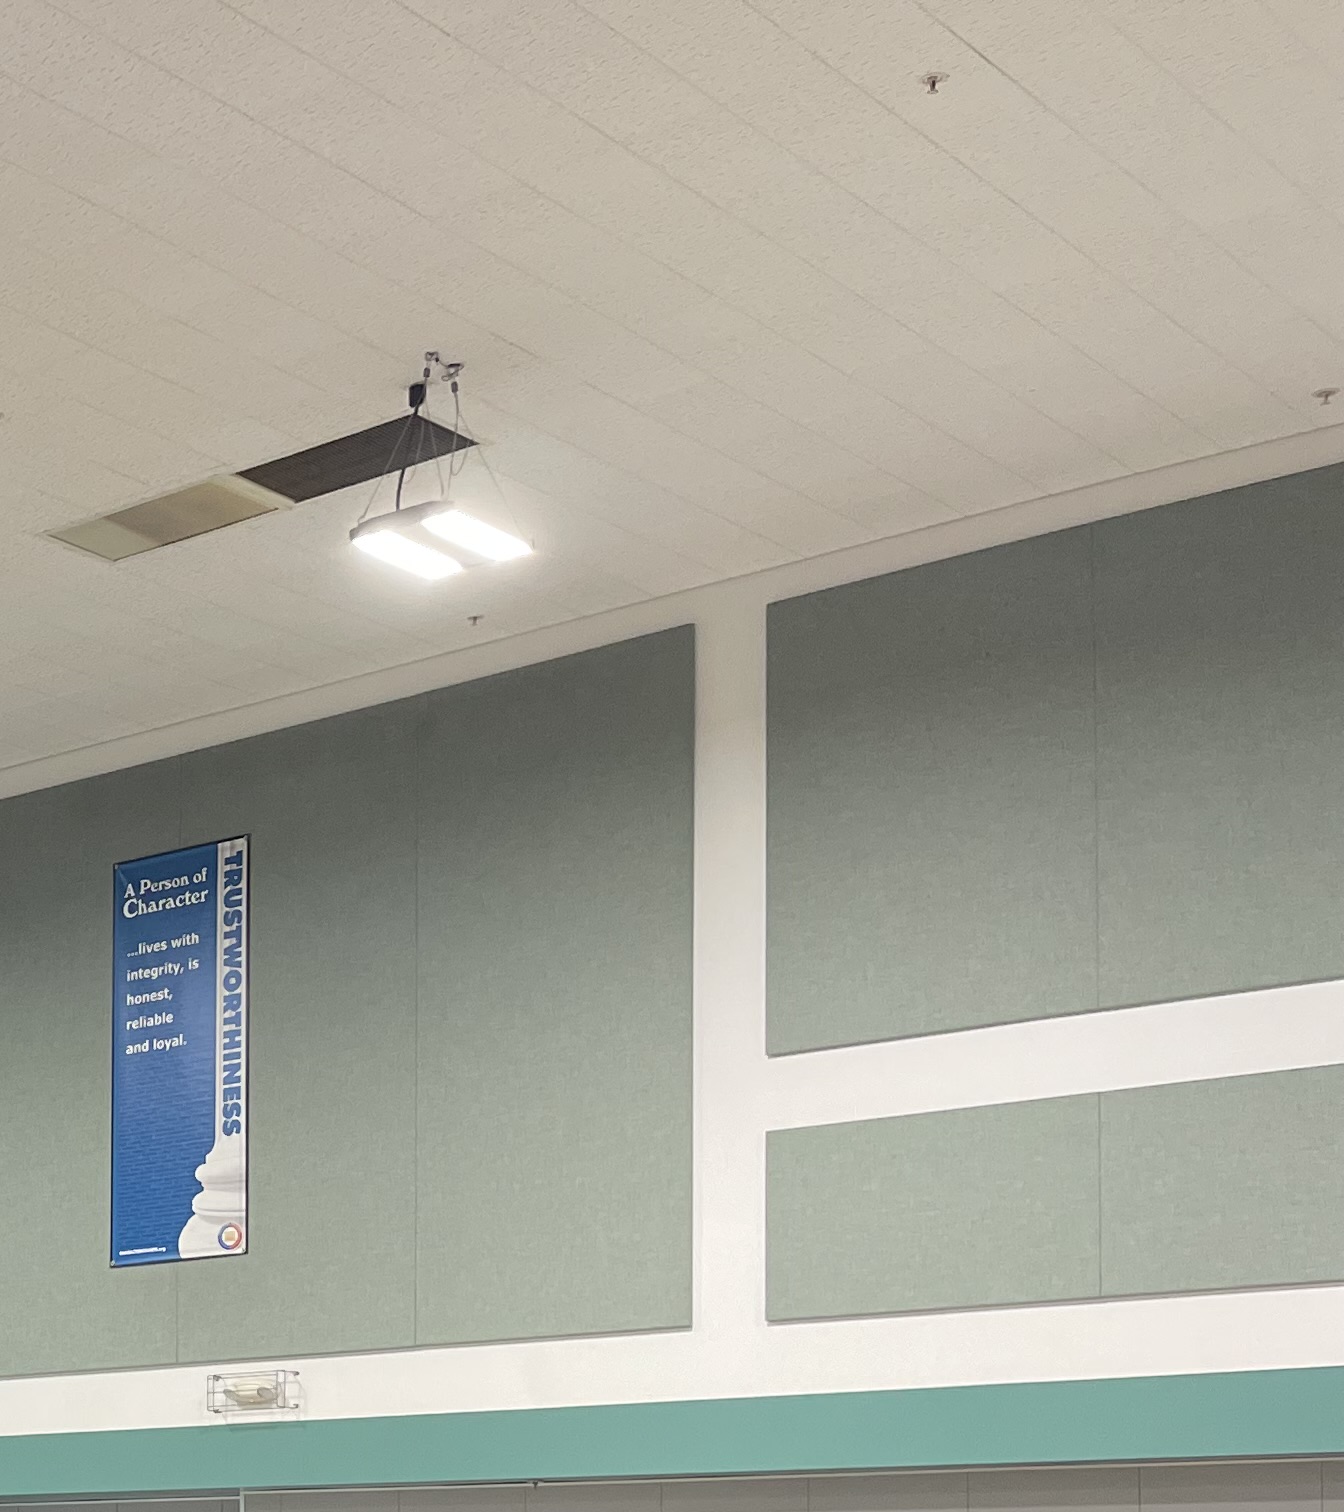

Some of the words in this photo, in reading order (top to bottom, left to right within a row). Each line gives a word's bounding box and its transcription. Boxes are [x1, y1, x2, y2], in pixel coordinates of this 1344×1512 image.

[124, 883, 136, 899] A
[140, 875, 189, 896] Person
[192, 866, 208, 884] of
[122, 889, 209, 918] Character
[171, 932, 200, 948] with
[126, 960, 185, 982] integrity,
[188, 958, 200, 971] is
[126, 986, 173, 1006] honest,
[222, 850, 243, 1137] TRUSTWORTHINESS
[126, 1011, 174, 1031] reliable
[125, 1039, 149, 1055] and
[153, 1033, 188, 1052] loyal.
